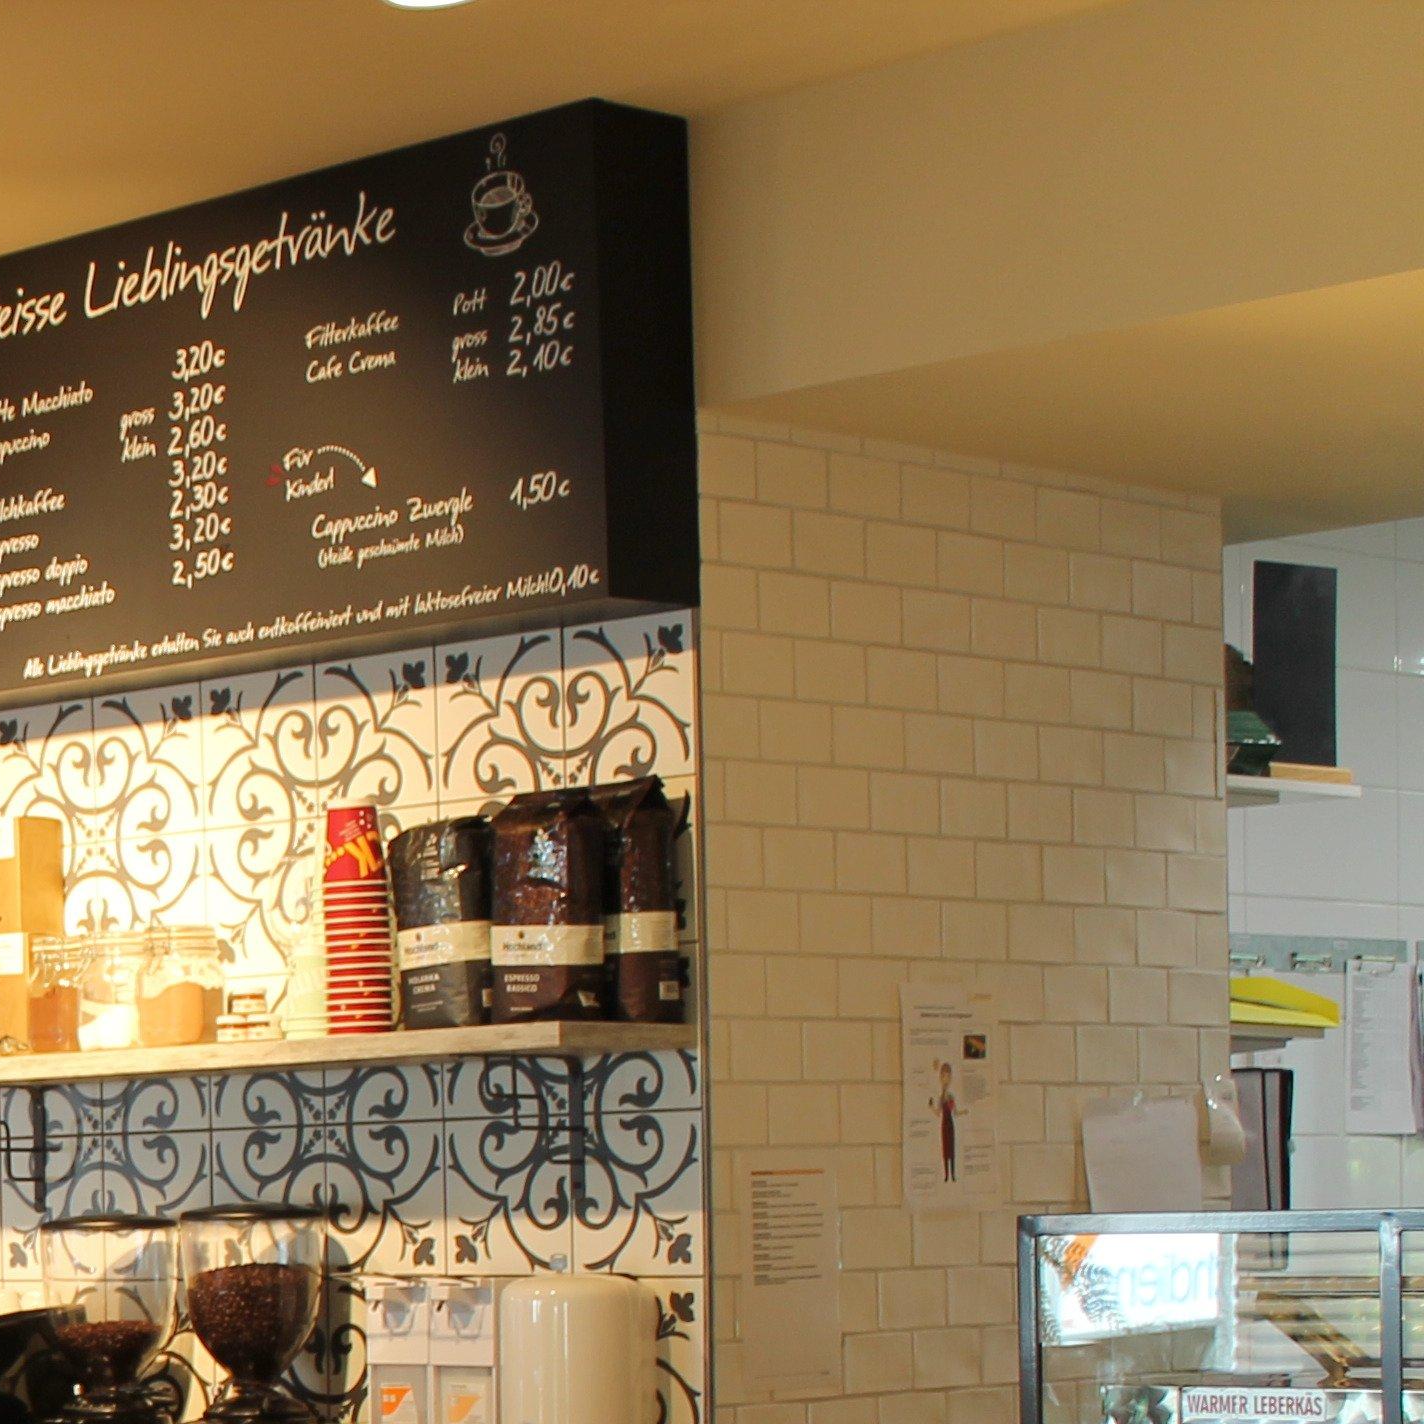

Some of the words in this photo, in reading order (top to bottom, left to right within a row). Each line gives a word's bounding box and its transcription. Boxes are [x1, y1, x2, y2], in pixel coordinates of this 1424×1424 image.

[84, 191, 396, 319] Lieblingsgetränke
[306, 310, 399, 349] Filterkaffee
[453, 288, 487, 316] Pott
[348, 351, 397, 375] Crema
[453, 330, 488, 363] gross
[453, 357, 489, 383] klein
[22, 381, 94, 417] Macchiato
[119, 407, 155, 441] gross
[121, 436, 156, 463] klein
[282, 447, 313, 471] Für
[311, 505, 399, 544] Cappuccino
[407, 486, 474, 525] Zwergle
[45, 553, 89, 587] doppio
[45, 580, 116, 614] macchiato
[202, 627, 222, 649] Sie
[226, 621, 255, 646] auch
[356, 599, 384, 623] und
[385, 595, 411, 619] mit
[414, 583, 502, 615] laktosefreier
[1186, 1394, 1249, 1414] WARMER
[1253, 1391, 1323, 1416] LEBERKÄS
